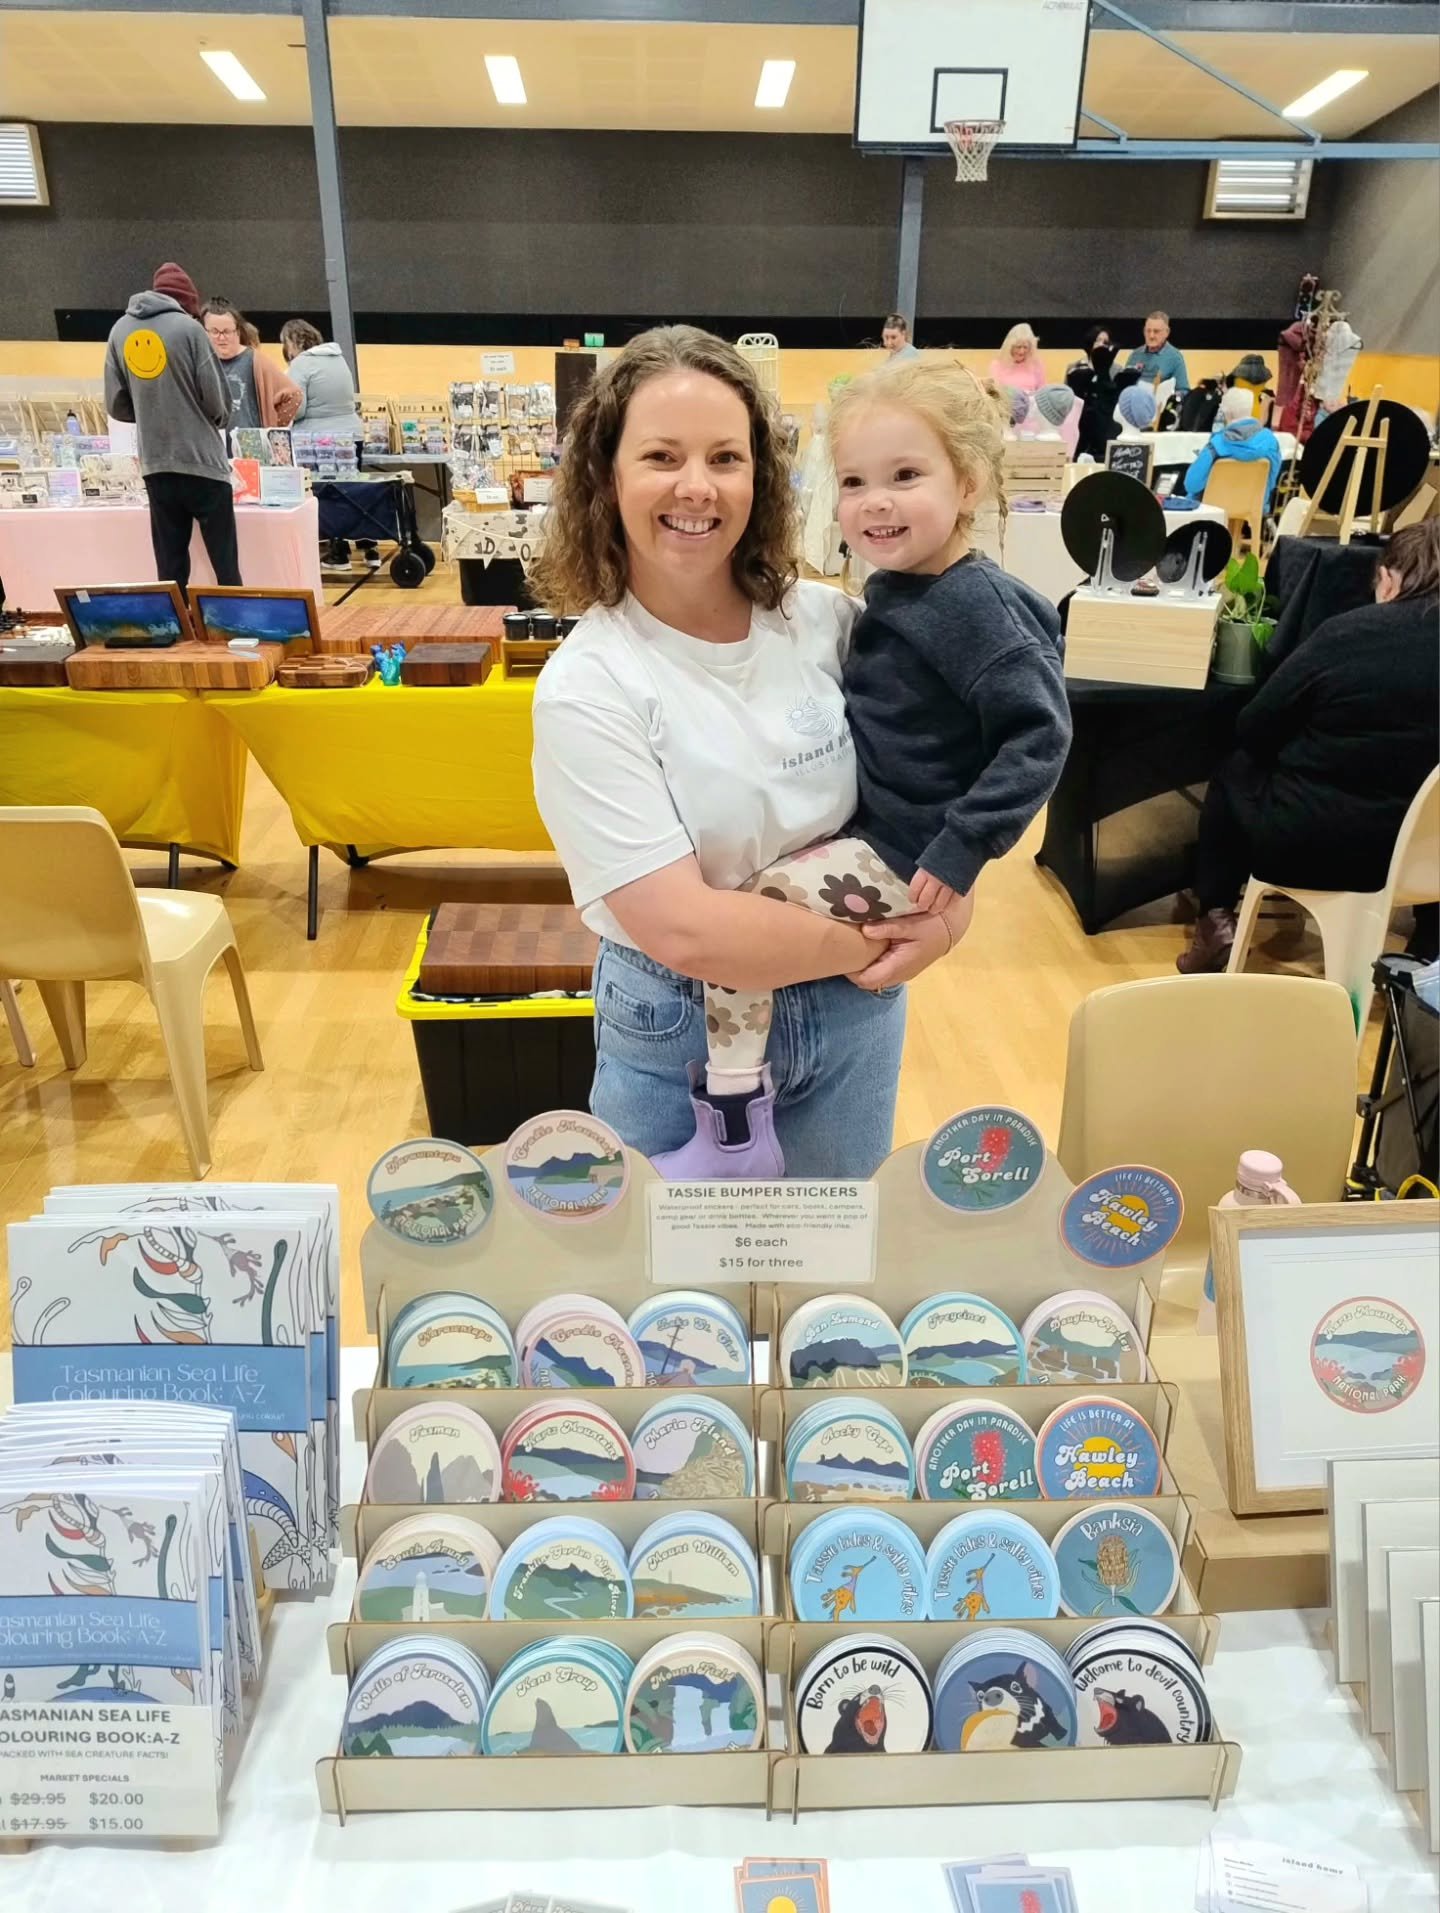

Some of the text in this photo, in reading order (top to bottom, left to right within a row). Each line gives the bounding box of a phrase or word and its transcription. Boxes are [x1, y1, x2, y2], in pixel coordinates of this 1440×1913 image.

[782, 739, 834, 770] island
[556, 1119, 617, 1161] Mountain
[934, 1113, 1038, 1151] ANOTHER DAY IN PARADISE
[938, 1146, 992, 1168] Port
[962, 1166, 1030, 1184] Sorell
[1114, 1171, 1175, 1207] LIFE IS BETTER AT
[528, 1185, 609, 1211] NATIONAL PARK
[667, 1186, 858, 1198] TASSIE BUMPER STICKERS
[397, 1208, 478, 1239] NATIONAL PARK
[1089, 1188, 1159, 1233] Hawley
[735, 1237, 788, 1248] $6 each
[1082, 1210, 1141, 1247] Beach
[719, 1257, 804, 1268] $15 for three
[805, 1311, 881, 1343] Ben Lomond
[59, 1363, 259, 1384] Tasmanian Sea Life
[1332, 1375, 1407, 1401] NATIONAL PARK
[52, 1383, 267, 1404] Colouring Book: A-Z
[409, 1425, 461, 1443] Tasman
[1059, 1409, 1137, 1432] LIFE IS BETTER AT
[644, 1417, 737, 1457] Maria Island
[821, 1424, 895, 1455] Rocky Cape
[928, 1416, 1030, 1471] ANOTHER DAY IN PARADISE
[1054, 1443, 1139, 1469] Hawley
[939, 1460, 990, 1490] Port
[966, 1468, 1034, 1500] Sorell
[1064, 1469, 1135, 1491] Beach
[1080, 1511, 1144, 1541] Banksia
[380, 1538, 470, 1571] South Bruny
[646, 1539, 740, 1577] Mount William
[804, 1545, 839, 1584] Tassie
[872, 1535, 884, 1552] &
[884, 1544, 911, 1578] salty
[933, 1556, 958, 1601] Tassie
[987, 1532, 997, 1549] &
[1000, 1538, 1032, 1567] salty
[0, 1611, 161, 1629] asmanian Sea Life
[0, 1628, 74, 1649] olouring
[138, 1629, 168, 1647] A-Z
[356, 1663, 472, 1712] Walls of Jerusalem
[515, 1666, 599, 1697] Kent Group
[650, 1661, 737, 1690] Mount Field
[806, 1657, 902, 1710] Born to be wild
[1127, 1657, 1143, 1673] to
[1145, 1664, 1178, 1691] devil
[1172, 1689, 1196, 1744] country
[0, 1709, 171, 1723] ASMANIAN SEA LIFE
[0, 1730, 92, 1744] OLOURING
[37, 1751, 64, 1759] WITH
[65, 1751, 83, 1759] SEA
[85, 1751, 135, 1759] CREATURE
[137, 1751, 169, 1760] FACTS!
[40, 1774, 130, 1783] MARKET SPECIALS
[10, 1792, 67, 1806] $29.95
[89, 1792, 144, 1806] $20.00
[10, 1817, 68, 1832] $17.95
[89, 1817, 144, 1832] $15.00
